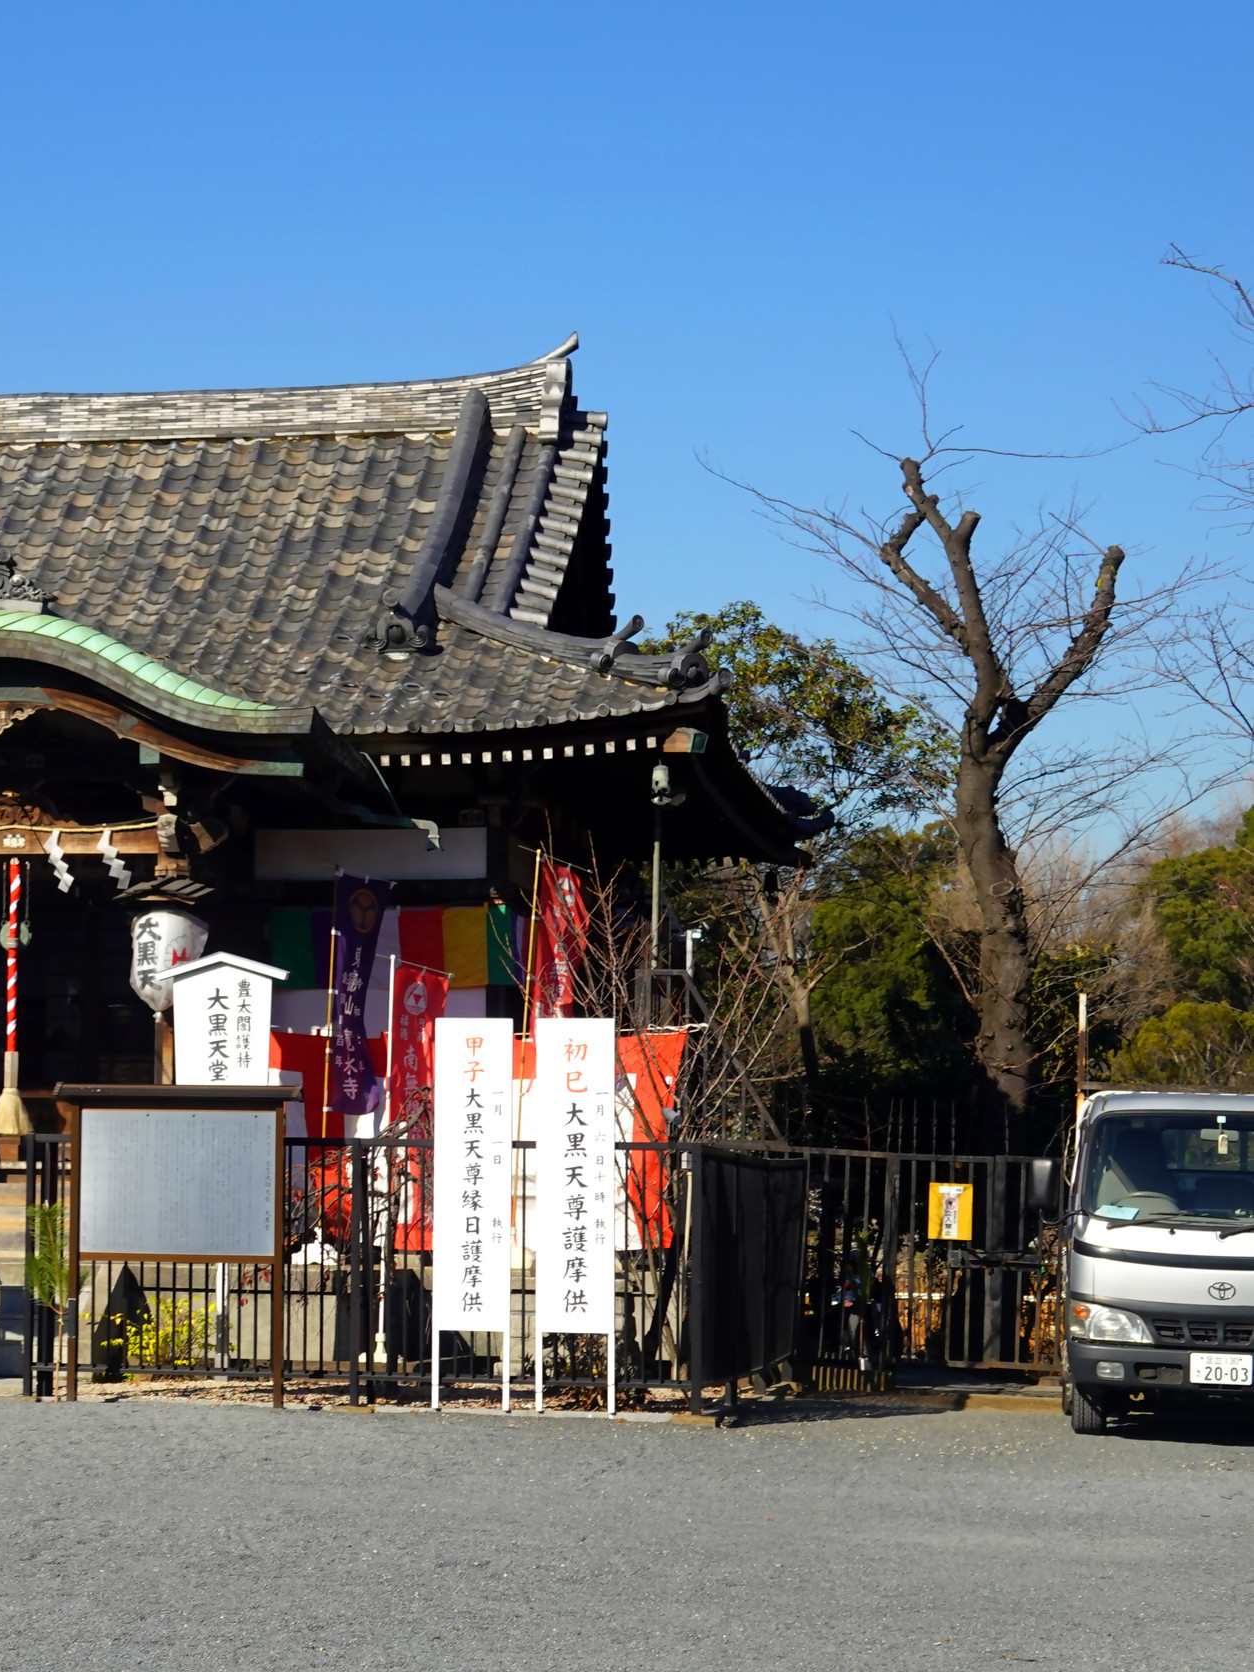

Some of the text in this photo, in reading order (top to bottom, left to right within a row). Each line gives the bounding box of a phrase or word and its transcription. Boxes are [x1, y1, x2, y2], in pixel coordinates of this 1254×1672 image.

[136, 917, 162, 991] 大黒天
[207, 988, 231, 1082] 大黒天堂
[236, 979, 253, 1069] 豊太閤護持
[1204, 1366, 1249, 1383] 20-03
